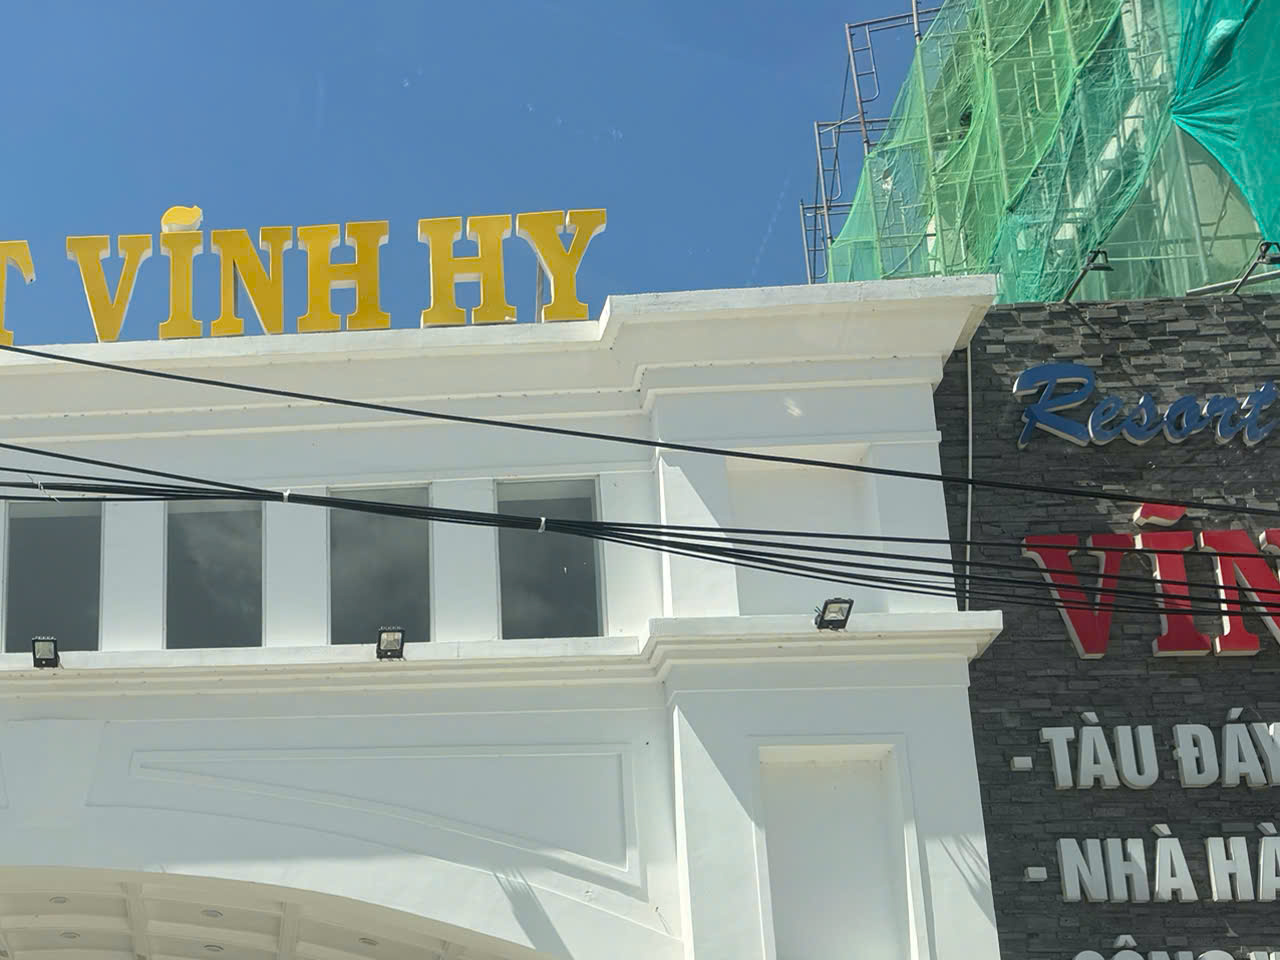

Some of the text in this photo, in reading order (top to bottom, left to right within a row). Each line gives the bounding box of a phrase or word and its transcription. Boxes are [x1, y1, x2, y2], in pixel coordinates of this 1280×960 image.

[417, 207, 607, 328] HY
[1012, 361, 1279, 449] Resort
[1039, 712, 1159, 790] TÀU
[1172, 707, 1280, 790] ĐÁY
[1057, 823, 1198, 903] NHÀ
